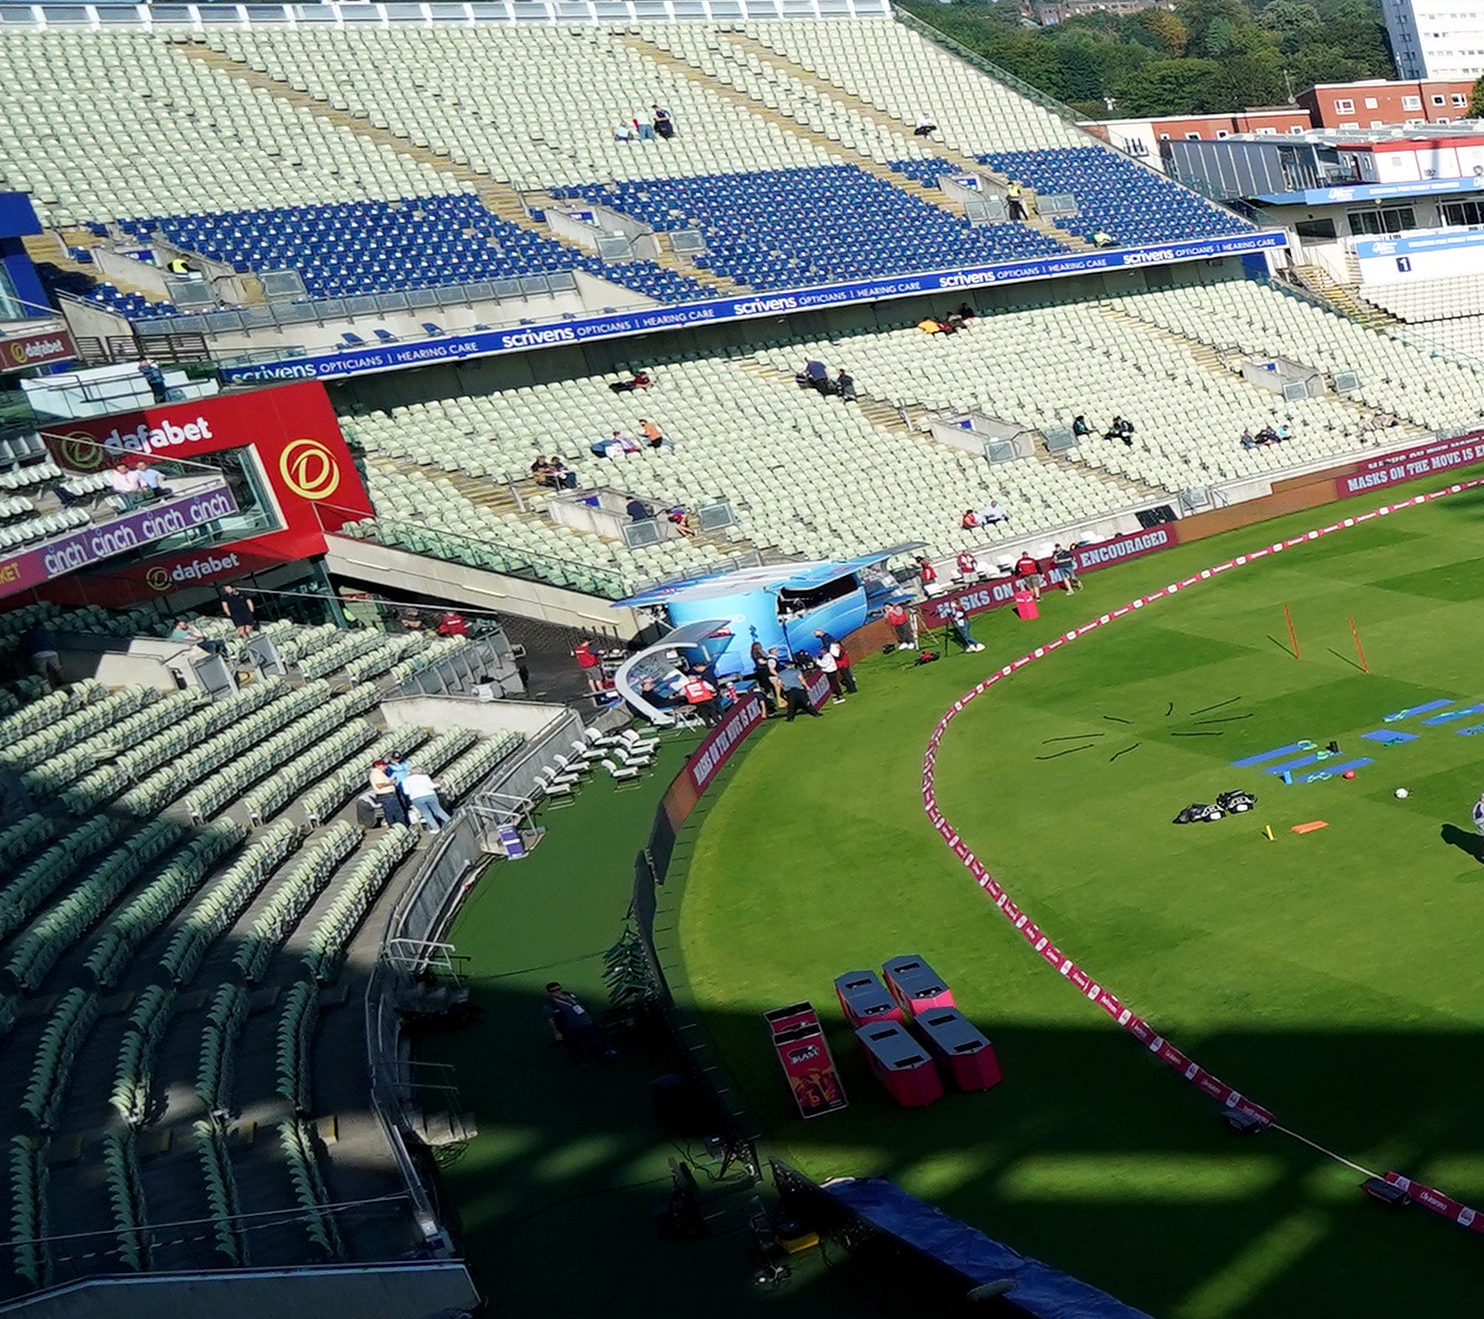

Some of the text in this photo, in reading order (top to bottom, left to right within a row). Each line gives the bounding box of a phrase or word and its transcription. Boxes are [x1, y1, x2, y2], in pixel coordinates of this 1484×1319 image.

[1122, 237, 1276, 265] scrivens OPTICIANS HEARING CARE
[939, 258, 1107, 288] scrivens OPTICIANS HEARING CARE
[734, 282, 921, 315] scrivens OPTICIANS HEARING CARE
[502, 309, 715, 348] scrivens OPTICIANS HEARING CARE
[25, 338, 64, 358] dafabet
[320, 356, 383, 373] OPTICIANS
[397, 347, 447, 362] HEARING
[448, 342, 479, 353] CARE
[103, 417, 213, 457] dafabet
[1347, 472, 1388, 491] MASKS
[1389, 467, 1405, 480] ON
[1407, 461, 1430, 475] THE
[1432, 452, 1461, 469] MOVE
[1462, 448, 1473, 459] IS
[191, 496, 230, 522] cinch
[143, 511, 185, 539] cinch
[92, 527, 136, 557] cinch
[45, 545, 88, 574] cinch
[171, 552, 241, 582] dafabet
[993, 530, 1168, 601] ON ENCOURAGED
[790, 1048, 819, 1064] BLAST
